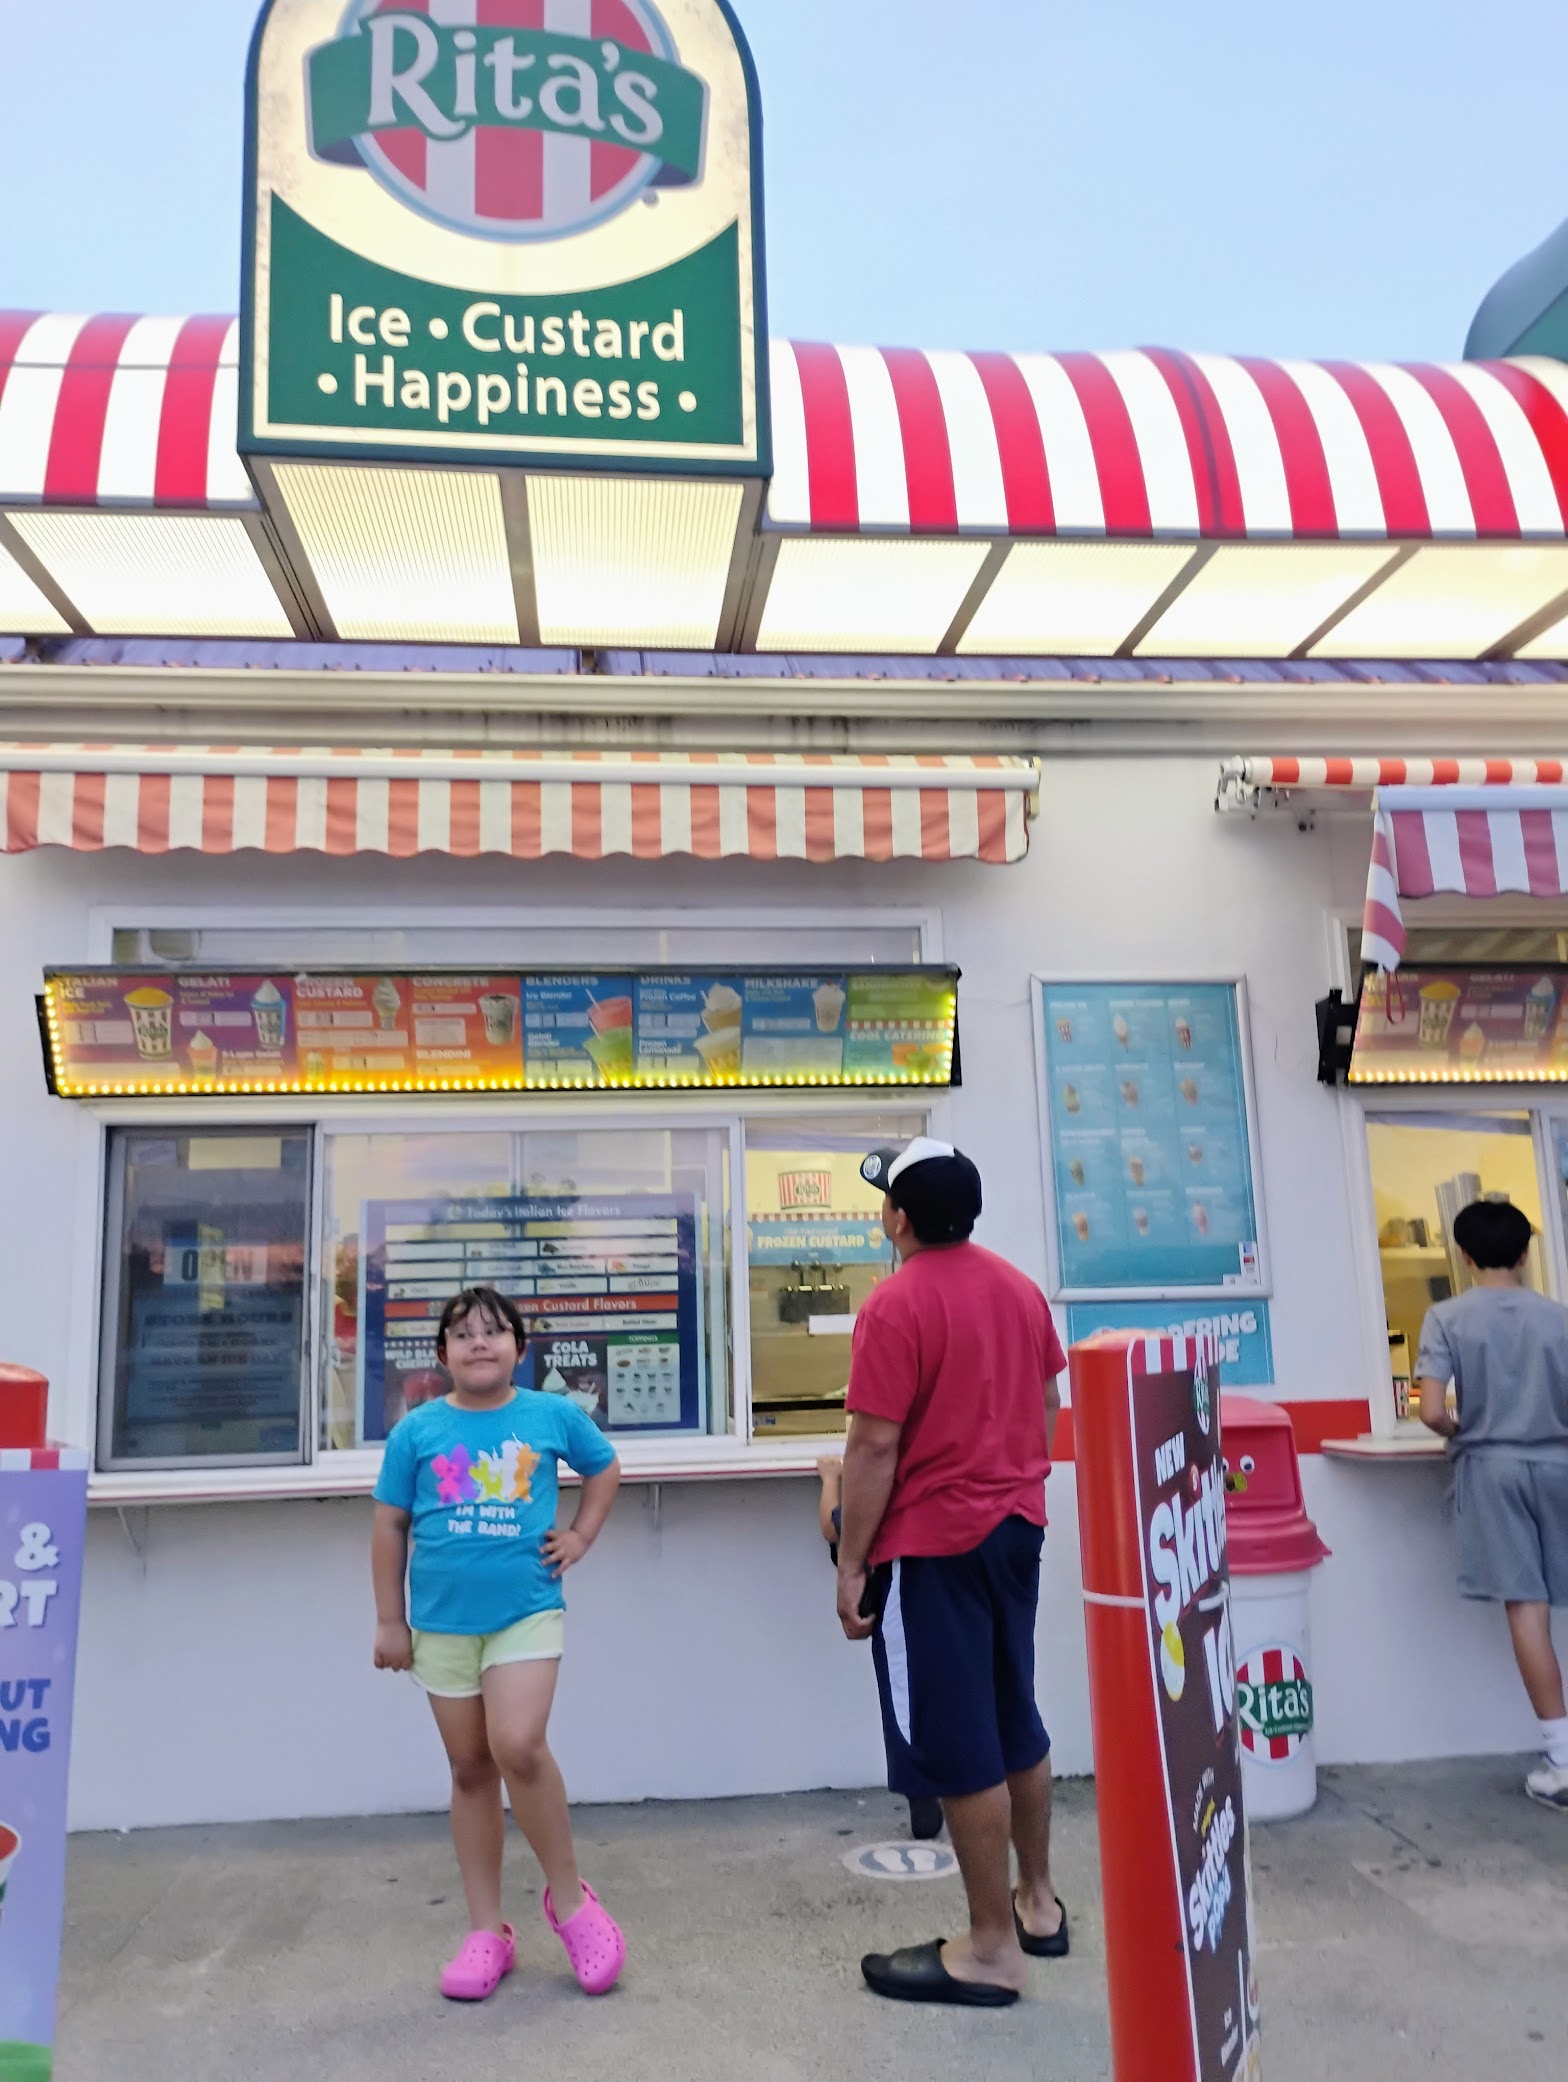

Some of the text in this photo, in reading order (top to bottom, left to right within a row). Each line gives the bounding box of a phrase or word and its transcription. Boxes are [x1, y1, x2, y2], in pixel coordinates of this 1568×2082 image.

[367, 14, 664, 145] Rita's
[329, 293, 685, 361] Ice Custard
[353, 353, 661, 426] Happiness
[295, 987, 364, 999] CUSTARD
[515, 1205, 553, 1218] Italian
[556, 1205, 575, 1217] Ice
[577, 1204, 621, 1217] Flavors
[757, 1234, 866, 1249] FROZEN CUSTARD
[543, 1298, 590, 1312] Custard
[593, 1297, 637, 1310] Flavors
[552, 1340, 590, 1354] COLA
[544, 1352, 598, 1367] TREATS
[1154, 1430, 1186, 1488] NEW
[479, 1505, 516, 1519] WITH
[1237, 1679, 1310, 1731] Rita's
